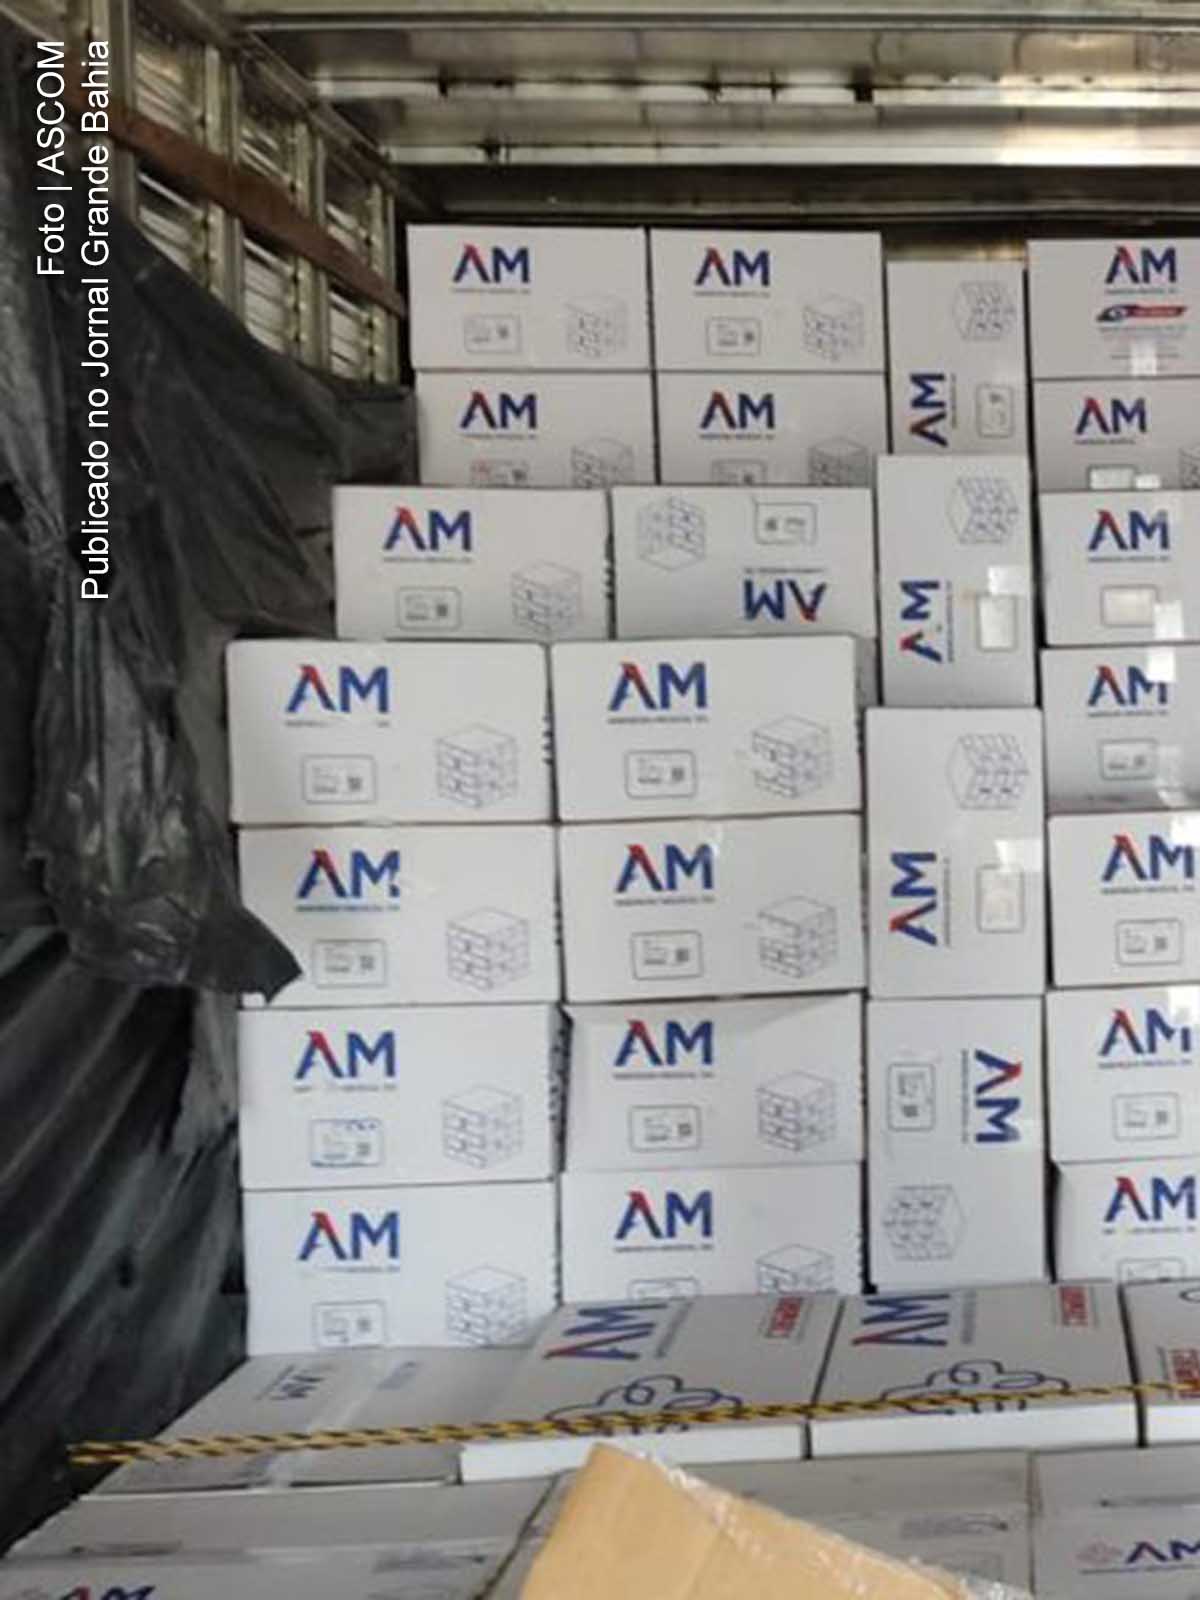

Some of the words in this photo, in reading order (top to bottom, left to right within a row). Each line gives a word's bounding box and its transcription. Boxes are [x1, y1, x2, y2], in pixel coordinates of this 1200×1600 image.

[453, 245, 530, 284] AM
[695, 248, 770, 287] AM
[1105, 246, 1177, 284] AM
[460, 391, 537, 429] AM
[700, 392, 775, 430] AM
[909, 373, 948, 448] AM
[1075, 397, 1147, 435] AM
[383, 507, 472, 552] AM
[1088, 510, 1170, 551] AM
[744, 579, 826, 622] AM
[900, 580, 942, 664] AM
[286, 664, 389, 714] AM
[608, 662, 707, 711] AM
[1087, 665, 1168, 707] AM
[296, 849, 400, 900] AM
[616, 844, 714, 893] AM
[1101, 835, 1194, 882] AM
[889, 852, 937, 946] AM
[294, 1031, 395, 1080] AM
[614, 1019, 714, 1067] AM
[1098, 1009, 1192, 1057] AM
[974, 1049, 1022, 1143] AM
[615, 1190, 713, 1240] AM
[1104, 1176, 1196, 1223] AM
[298, 1211, 399, 1261] AM
[542, 1302, 668, 1361] AM
[850, 1294, 952, 1347] AM
